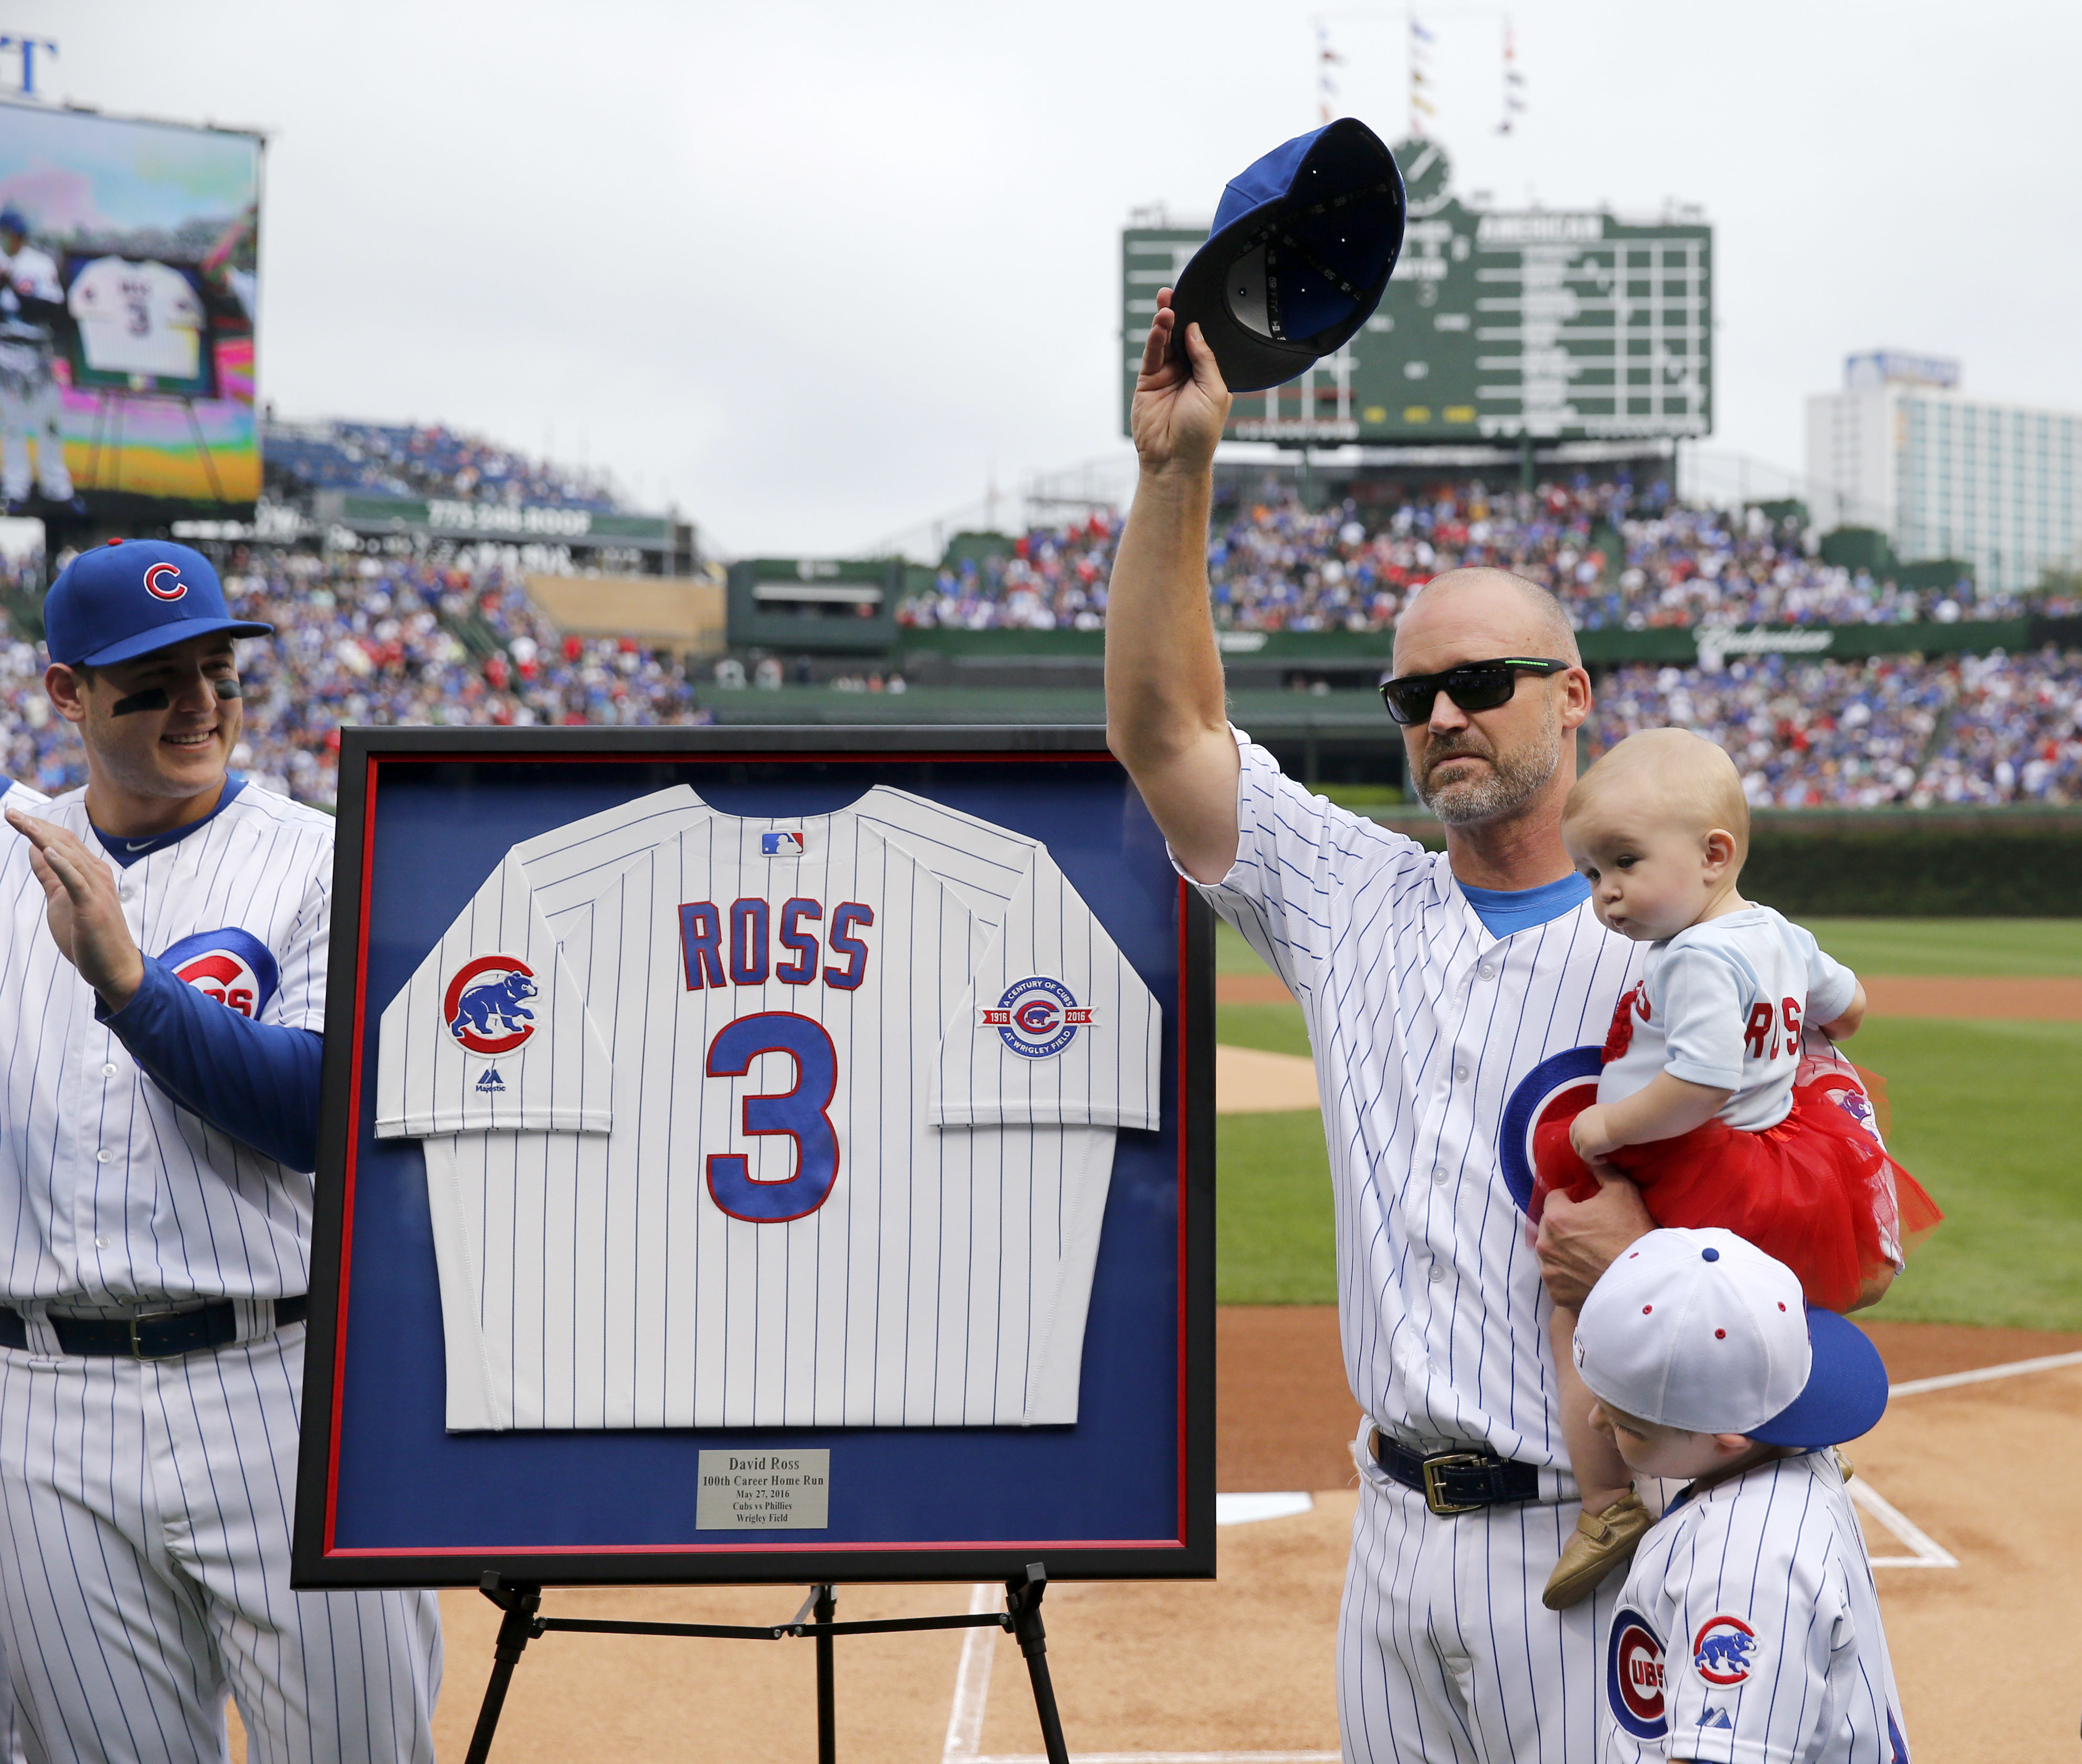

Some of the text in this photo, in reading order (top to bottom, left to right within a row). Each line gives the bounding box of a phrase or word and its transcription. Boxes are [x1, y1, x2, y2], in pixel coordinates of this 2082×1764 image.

[143, 562, 188, 602] C
[678, 897, 875, 991] ROSS
[1007, 980, 1043, 1000] CENTURY
[1044, 981, 1057, 990] OF
[1056, 988, 1074, 1007] CUBS
[990, 1012, 1007, 1022] 1916
[1067, 1011, 1086, 1022] 2016
[1004, 1030, 1071, 1054] AT WRIGLEY FIELD
[476, 1085, 506, 1094] Majestic
[706, 1011, 840, 1224] 3
[729, 1457, 800, 1471] David Ross
[703, 1475, 824, 1486] 100th Career Home Run
[737, 1489, 790, 1500] May 27, 2016
[733, 1502, 752, 1510] Cubs
[765, 1502, 792, 1510] Phillies
[737, 1513, 788, 1524] Wrigley Field
